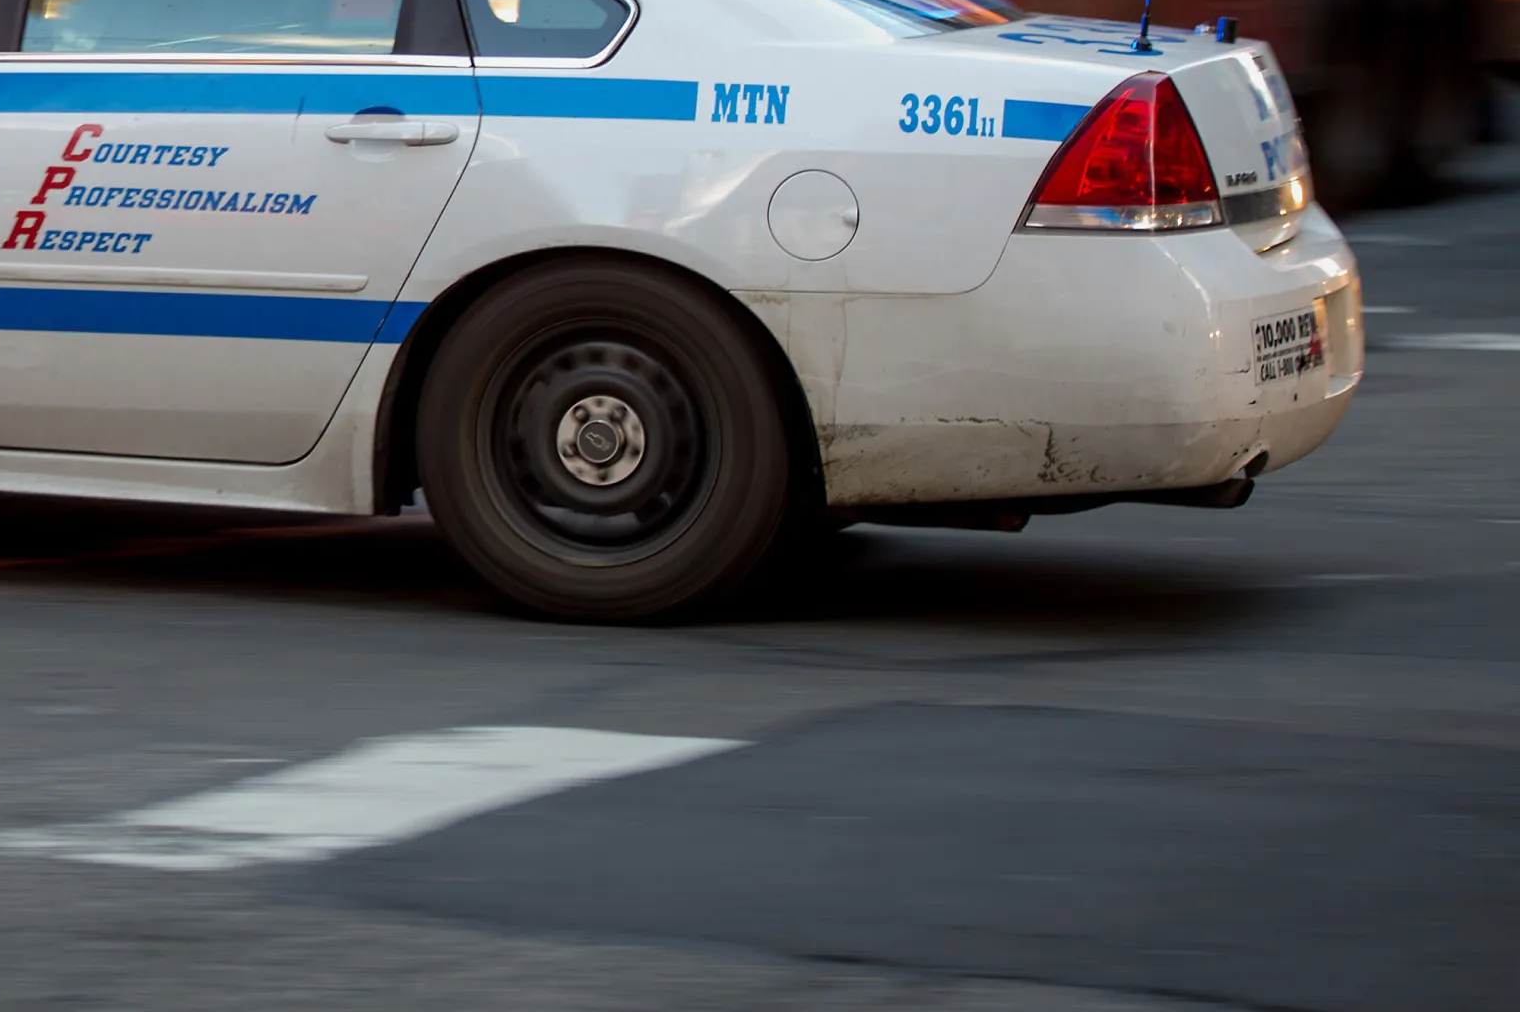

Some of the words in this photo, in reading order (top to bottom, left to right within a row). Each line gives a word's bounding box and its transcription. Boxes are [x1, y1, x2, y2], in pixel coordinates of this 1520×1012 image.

[711, 83, 790, 125] MTN
[61, 123, 229, 167] COURTESY
[30, 166, 318, 215] PROFESSIONALISM
[1, 210, 152, 253] RESPECT
